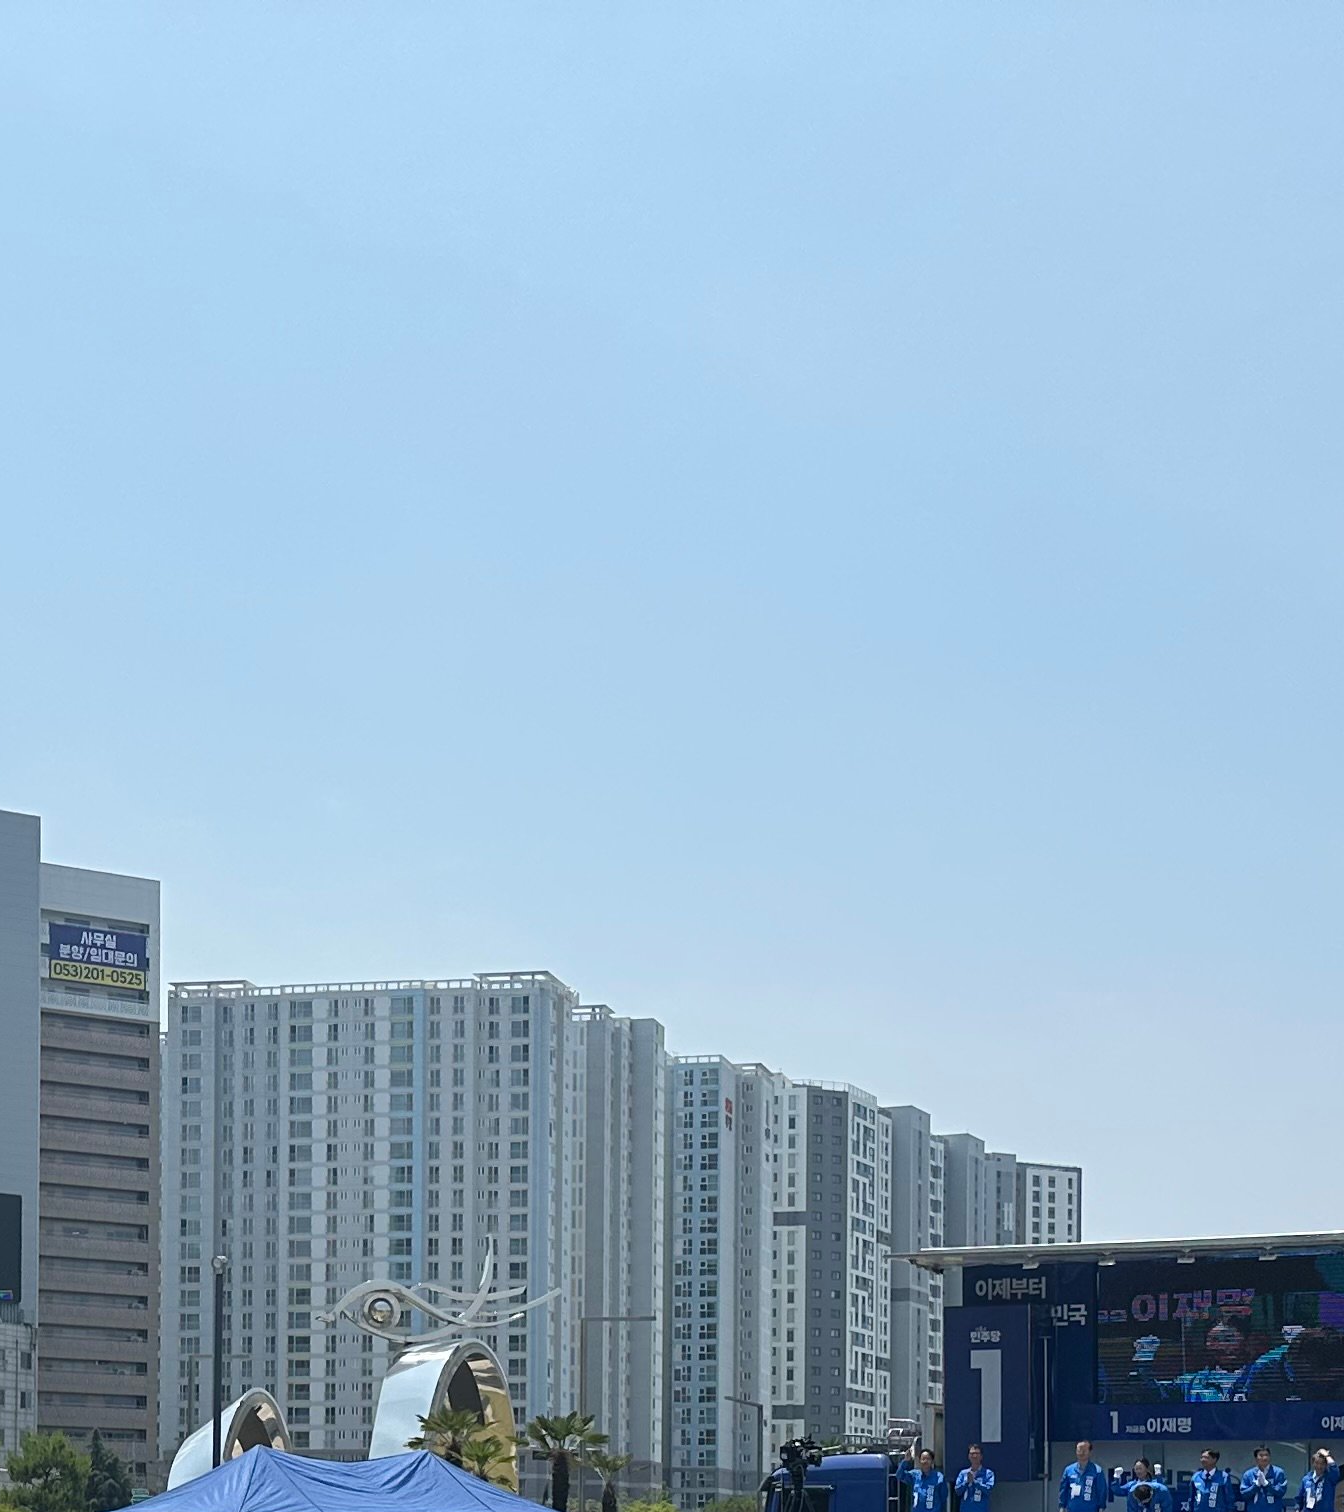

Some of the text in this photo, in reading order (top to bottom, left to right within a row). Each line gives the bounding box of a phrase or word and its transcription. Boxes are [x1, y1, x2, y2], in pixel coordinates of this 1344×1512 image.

[81, 931, 117, 949] 사무실
[59, 943, 138, 968] 분양/임대문의
[53, 962, 143, 986] 053)201-0525
[975, 1277, 1047, 1300] 이제부터
[1051, 1303, 1088, 1327] 민국
[969, 1349, 1002, 1443] 1
[1110, 1411, 1119, 1434] 1
[1146, 1417, 1192, 1433] 이재명
